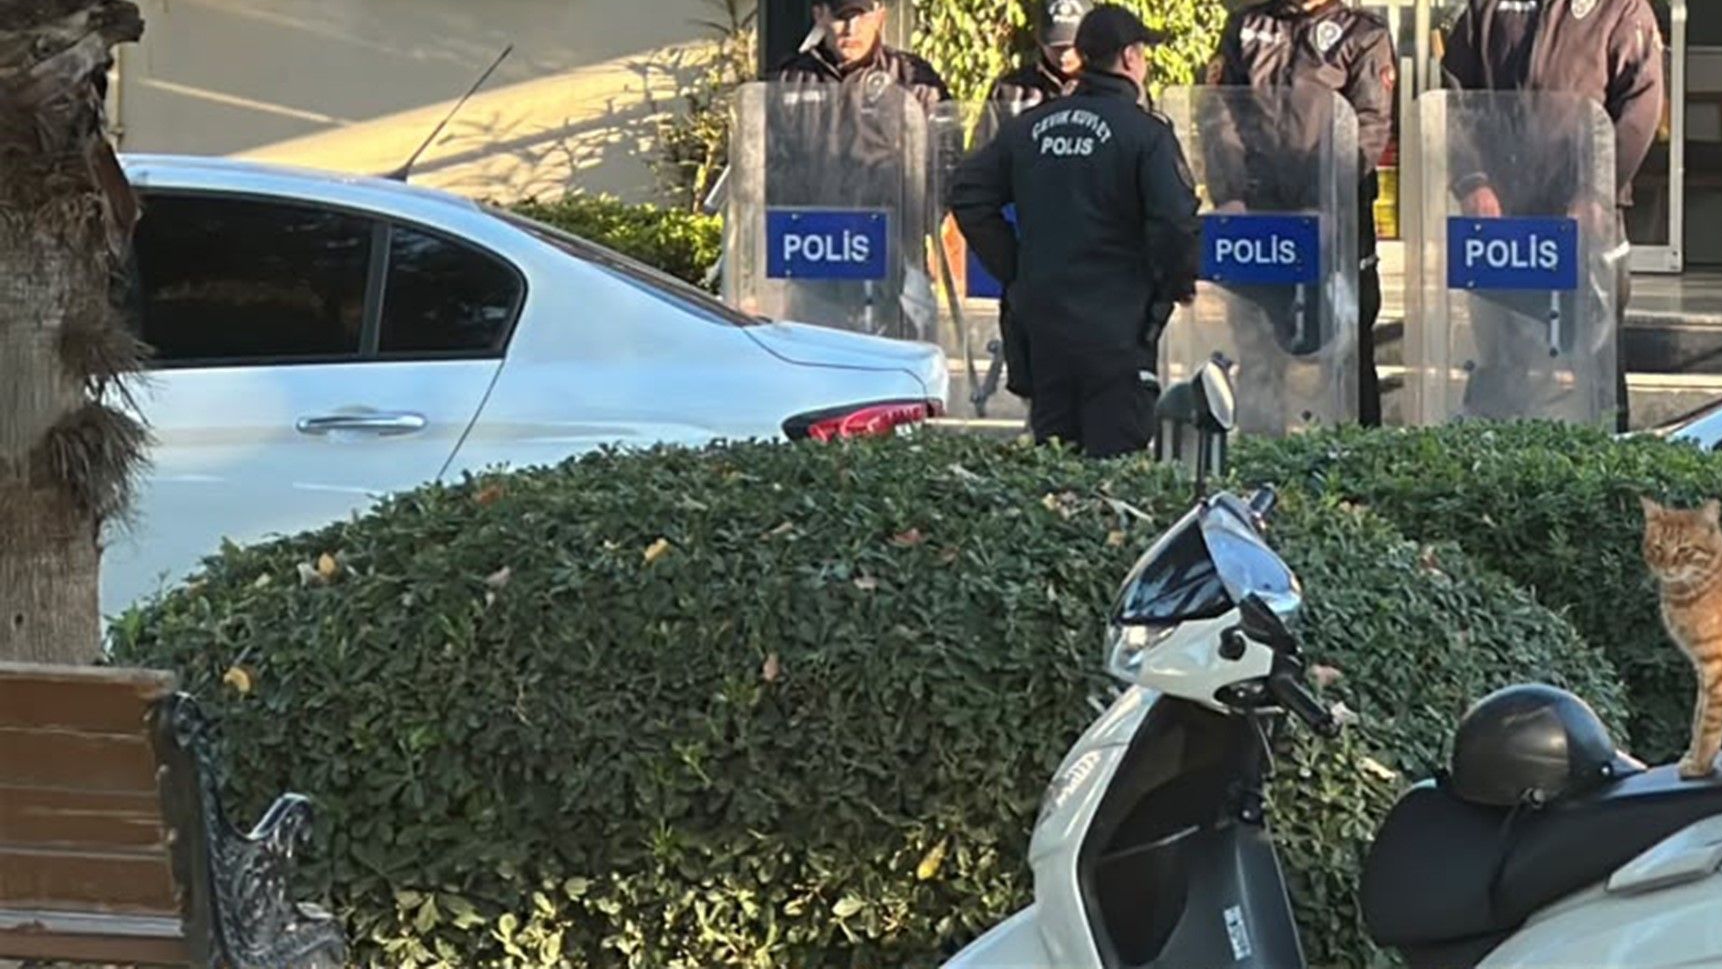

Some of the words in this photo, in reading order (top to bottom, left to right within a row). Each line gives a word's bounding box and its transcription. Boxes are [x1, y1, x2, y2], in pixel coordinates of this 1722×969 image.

[784, 229, 869, 262] POLİS
[1215, 234, 1296, 264] POLİS
[1465, 234, 1559, 268] POLİS
